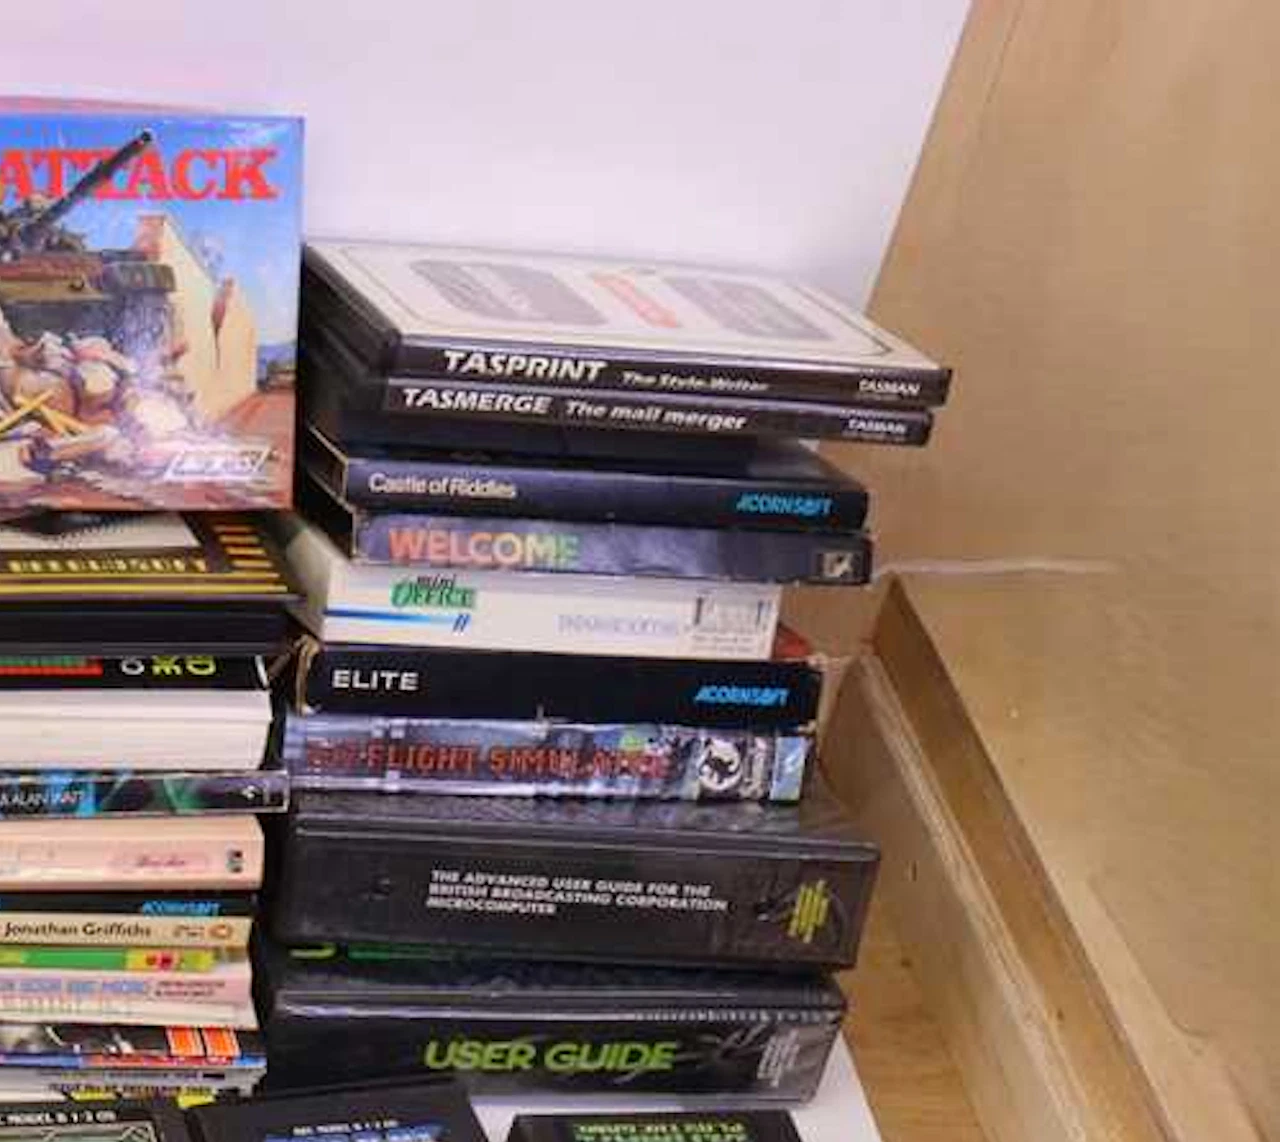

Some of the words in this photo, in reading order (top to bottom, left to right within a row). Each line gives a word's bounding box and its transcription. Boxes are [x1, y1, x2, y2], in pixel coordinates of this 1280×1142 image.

[443, 349, 608, 383] TASPRINT
[621, 370, 657, 386] The
[857, 378, 921, 397] TASMAN
[402, 387, 553, 416] TASMERGE
[564, 398, 606, 418] The
[610, 403, 661, 423] mail
[664, 409, 747, 432] merger
[847, 418, 908, 436] TASMAN
[368, 472, 427, 495] Castle
[427, 477, 447, 496] of
[448, 476, 517, 499] Riddles
[388, 528, 580, 566] WELCOME
[415, 573, 455, 590] mini
[331, 669, 420, 692] ELITE
[693, 685, 788, 706] ACORNSOFT
[365, 743, 476, 775] FLIGHT
[431, 869, 460, 884] THE
[464, 871, 550, 889] ADVANCED
[551, 877, 592, 890] USER
[595, 879, 644, 894] GUIDE
[646, 882, 680, 896] FOR
[682, 883, 712, 898] THE
[426, 895, 559, 916] MICROCOMPUTER
[428, 883, 488, 900] BRITISH
[490, 886, 613, 906] BROADCASTING
[615, 893, 728, 914] CORPORATION
[4, 920, 78, 938] Jonathan
[81, 921, 152, 938] Griffiths
[424, 1039, 537, 1071] USER
[543, 1041, 678, 1072] GUIDE
[7, 1113, 55, 1125] MODEL
